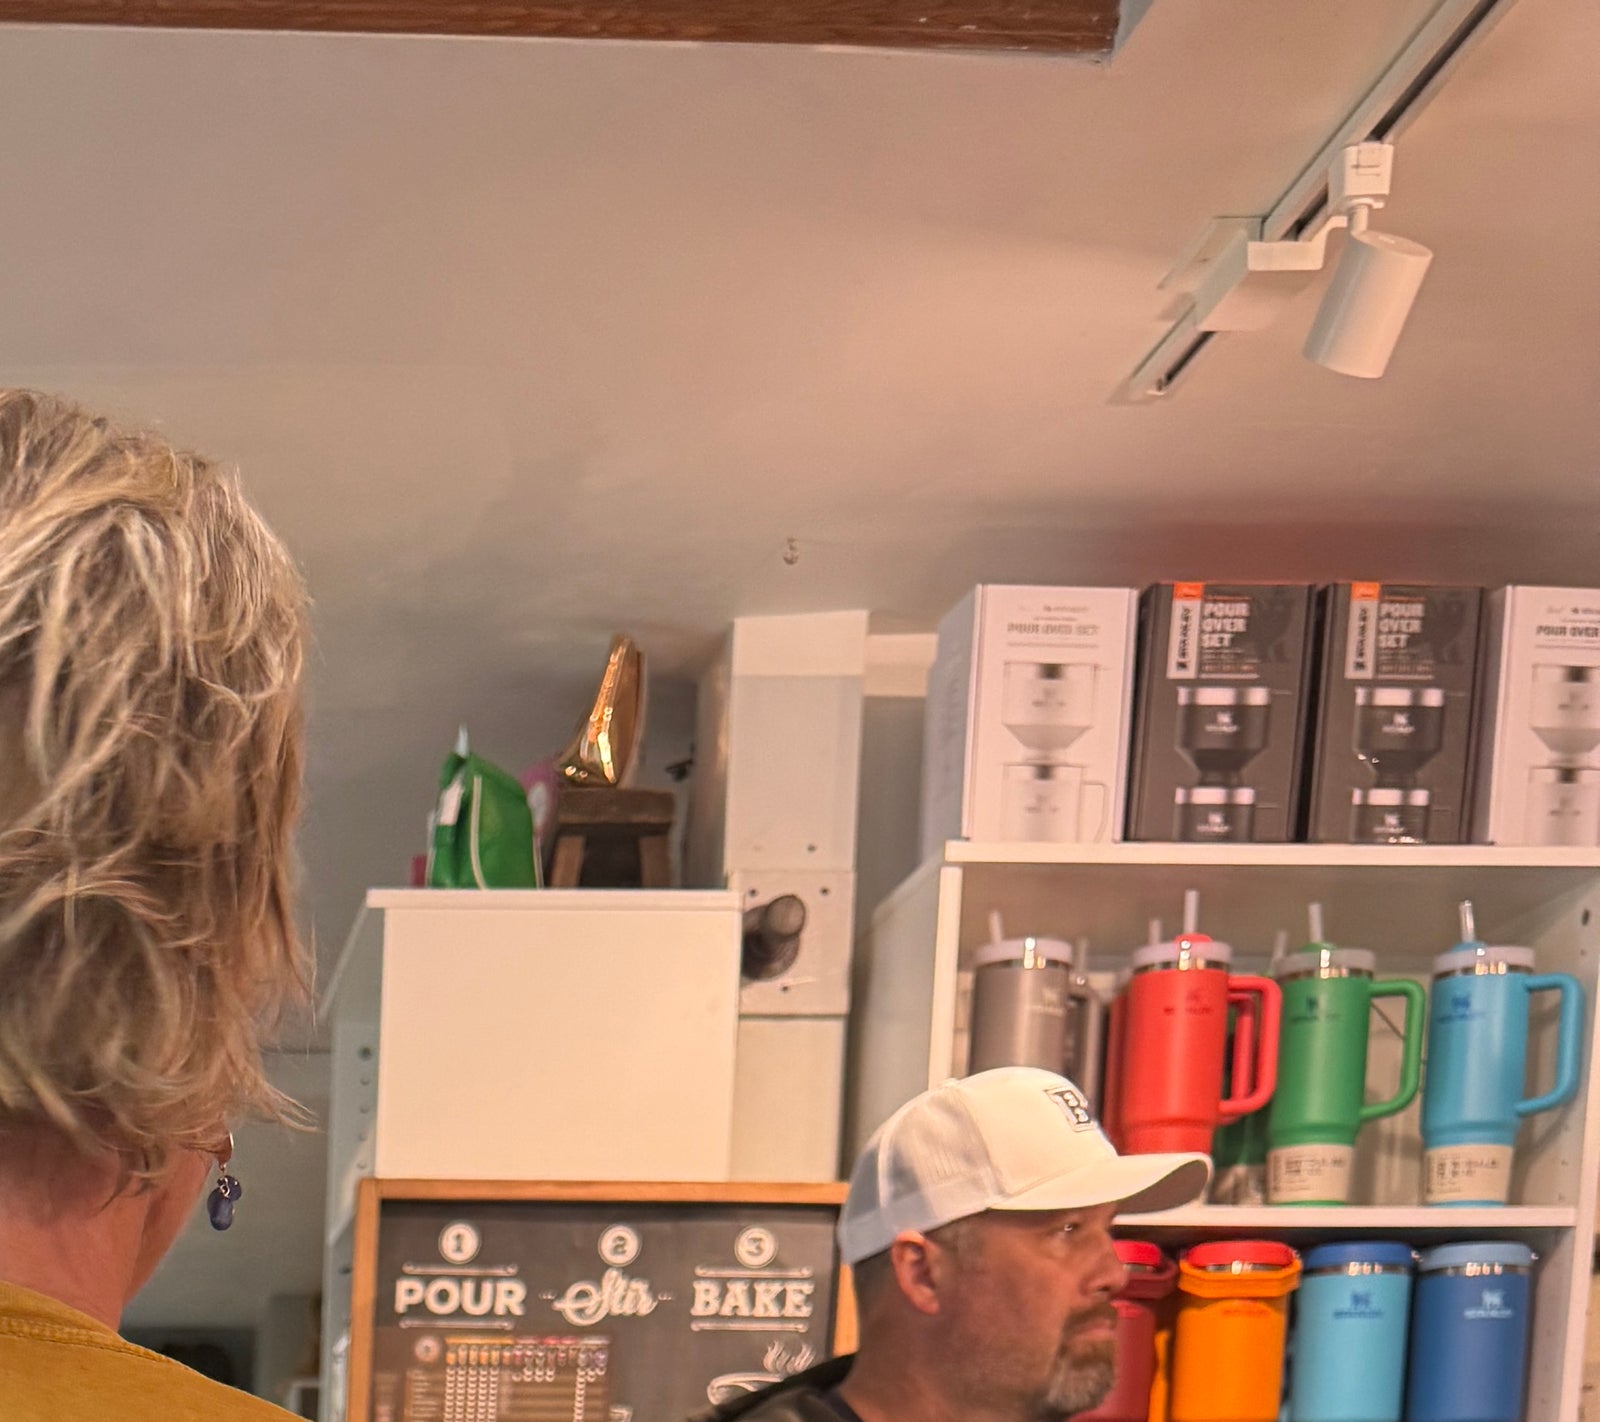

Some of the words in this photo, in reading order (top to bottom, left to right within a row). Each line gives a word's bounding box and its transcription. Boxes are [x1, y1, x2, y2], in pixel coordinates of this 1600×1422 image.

[1202, 602, 1250, 617] POUR
[1201, 618, 1247, 632] OVER
[395, 1278, 527, 1316] POUR
[690, 1279, 815, 1317] BAKE
